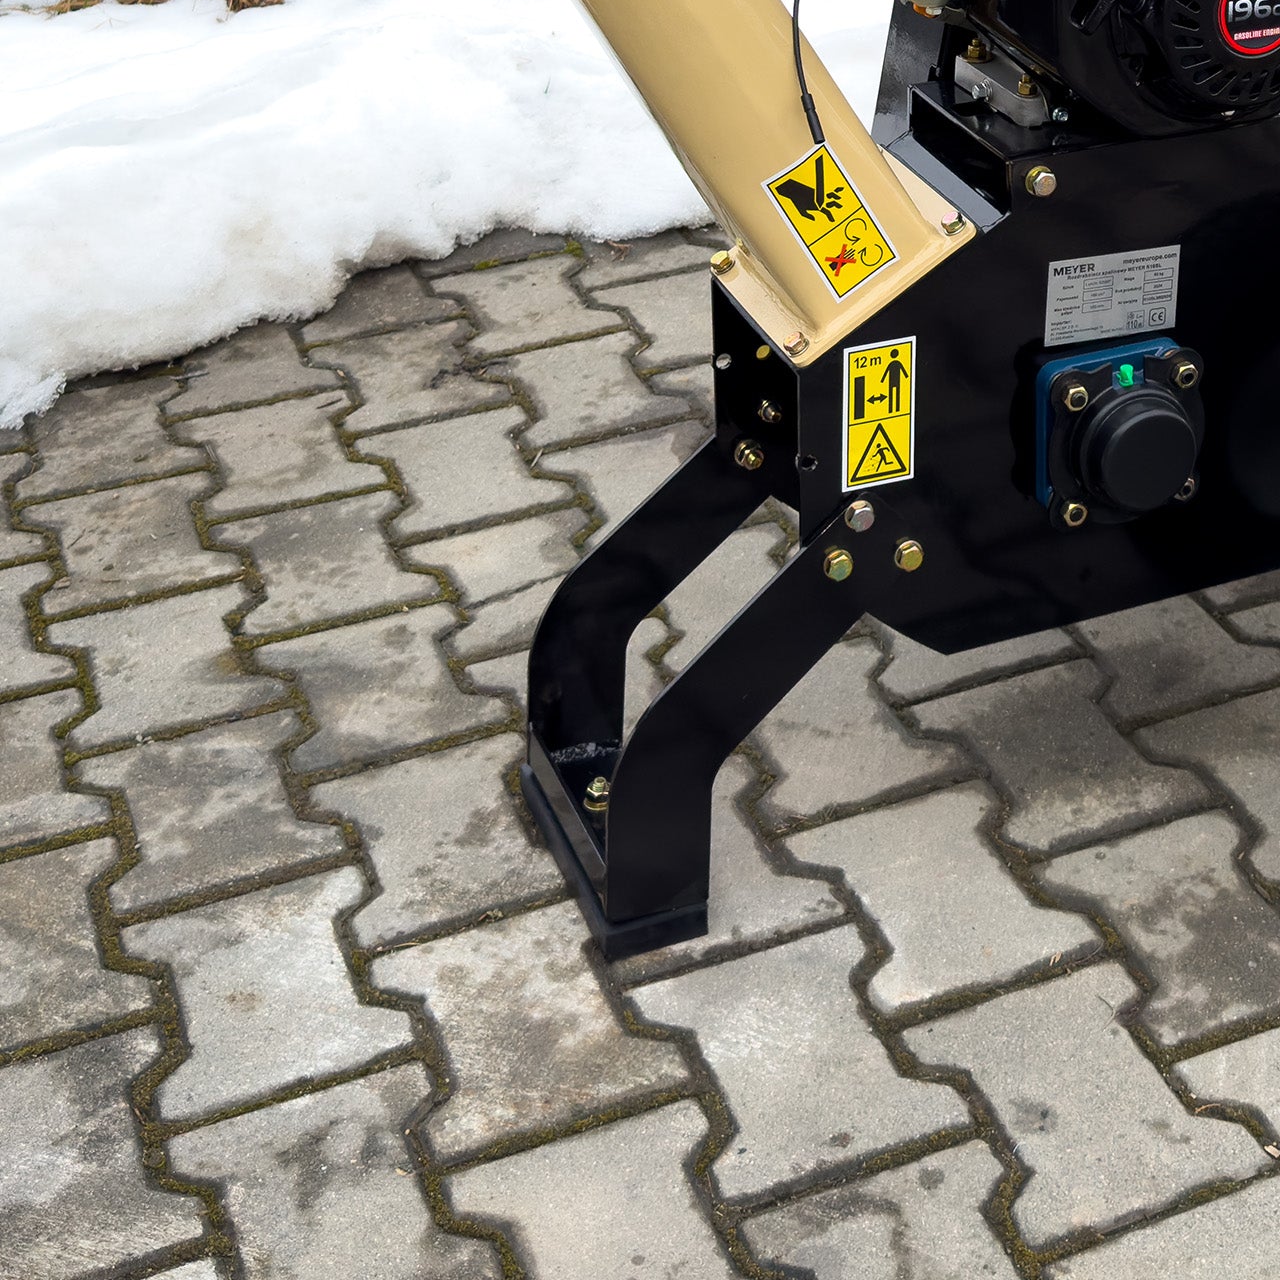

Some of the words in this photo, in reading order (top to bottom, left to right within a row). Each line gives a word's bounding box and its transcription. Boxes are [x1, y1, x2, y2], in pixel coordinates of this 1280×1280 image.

[1234, 30, 1261, 40] GASOLINE
[1123, 252, 1177, 264] meyereurope.com
[1053, 263, 1095, 277] MEYER
[854, 356, 867, 368] 12
[870, 356, 881, 366] m
